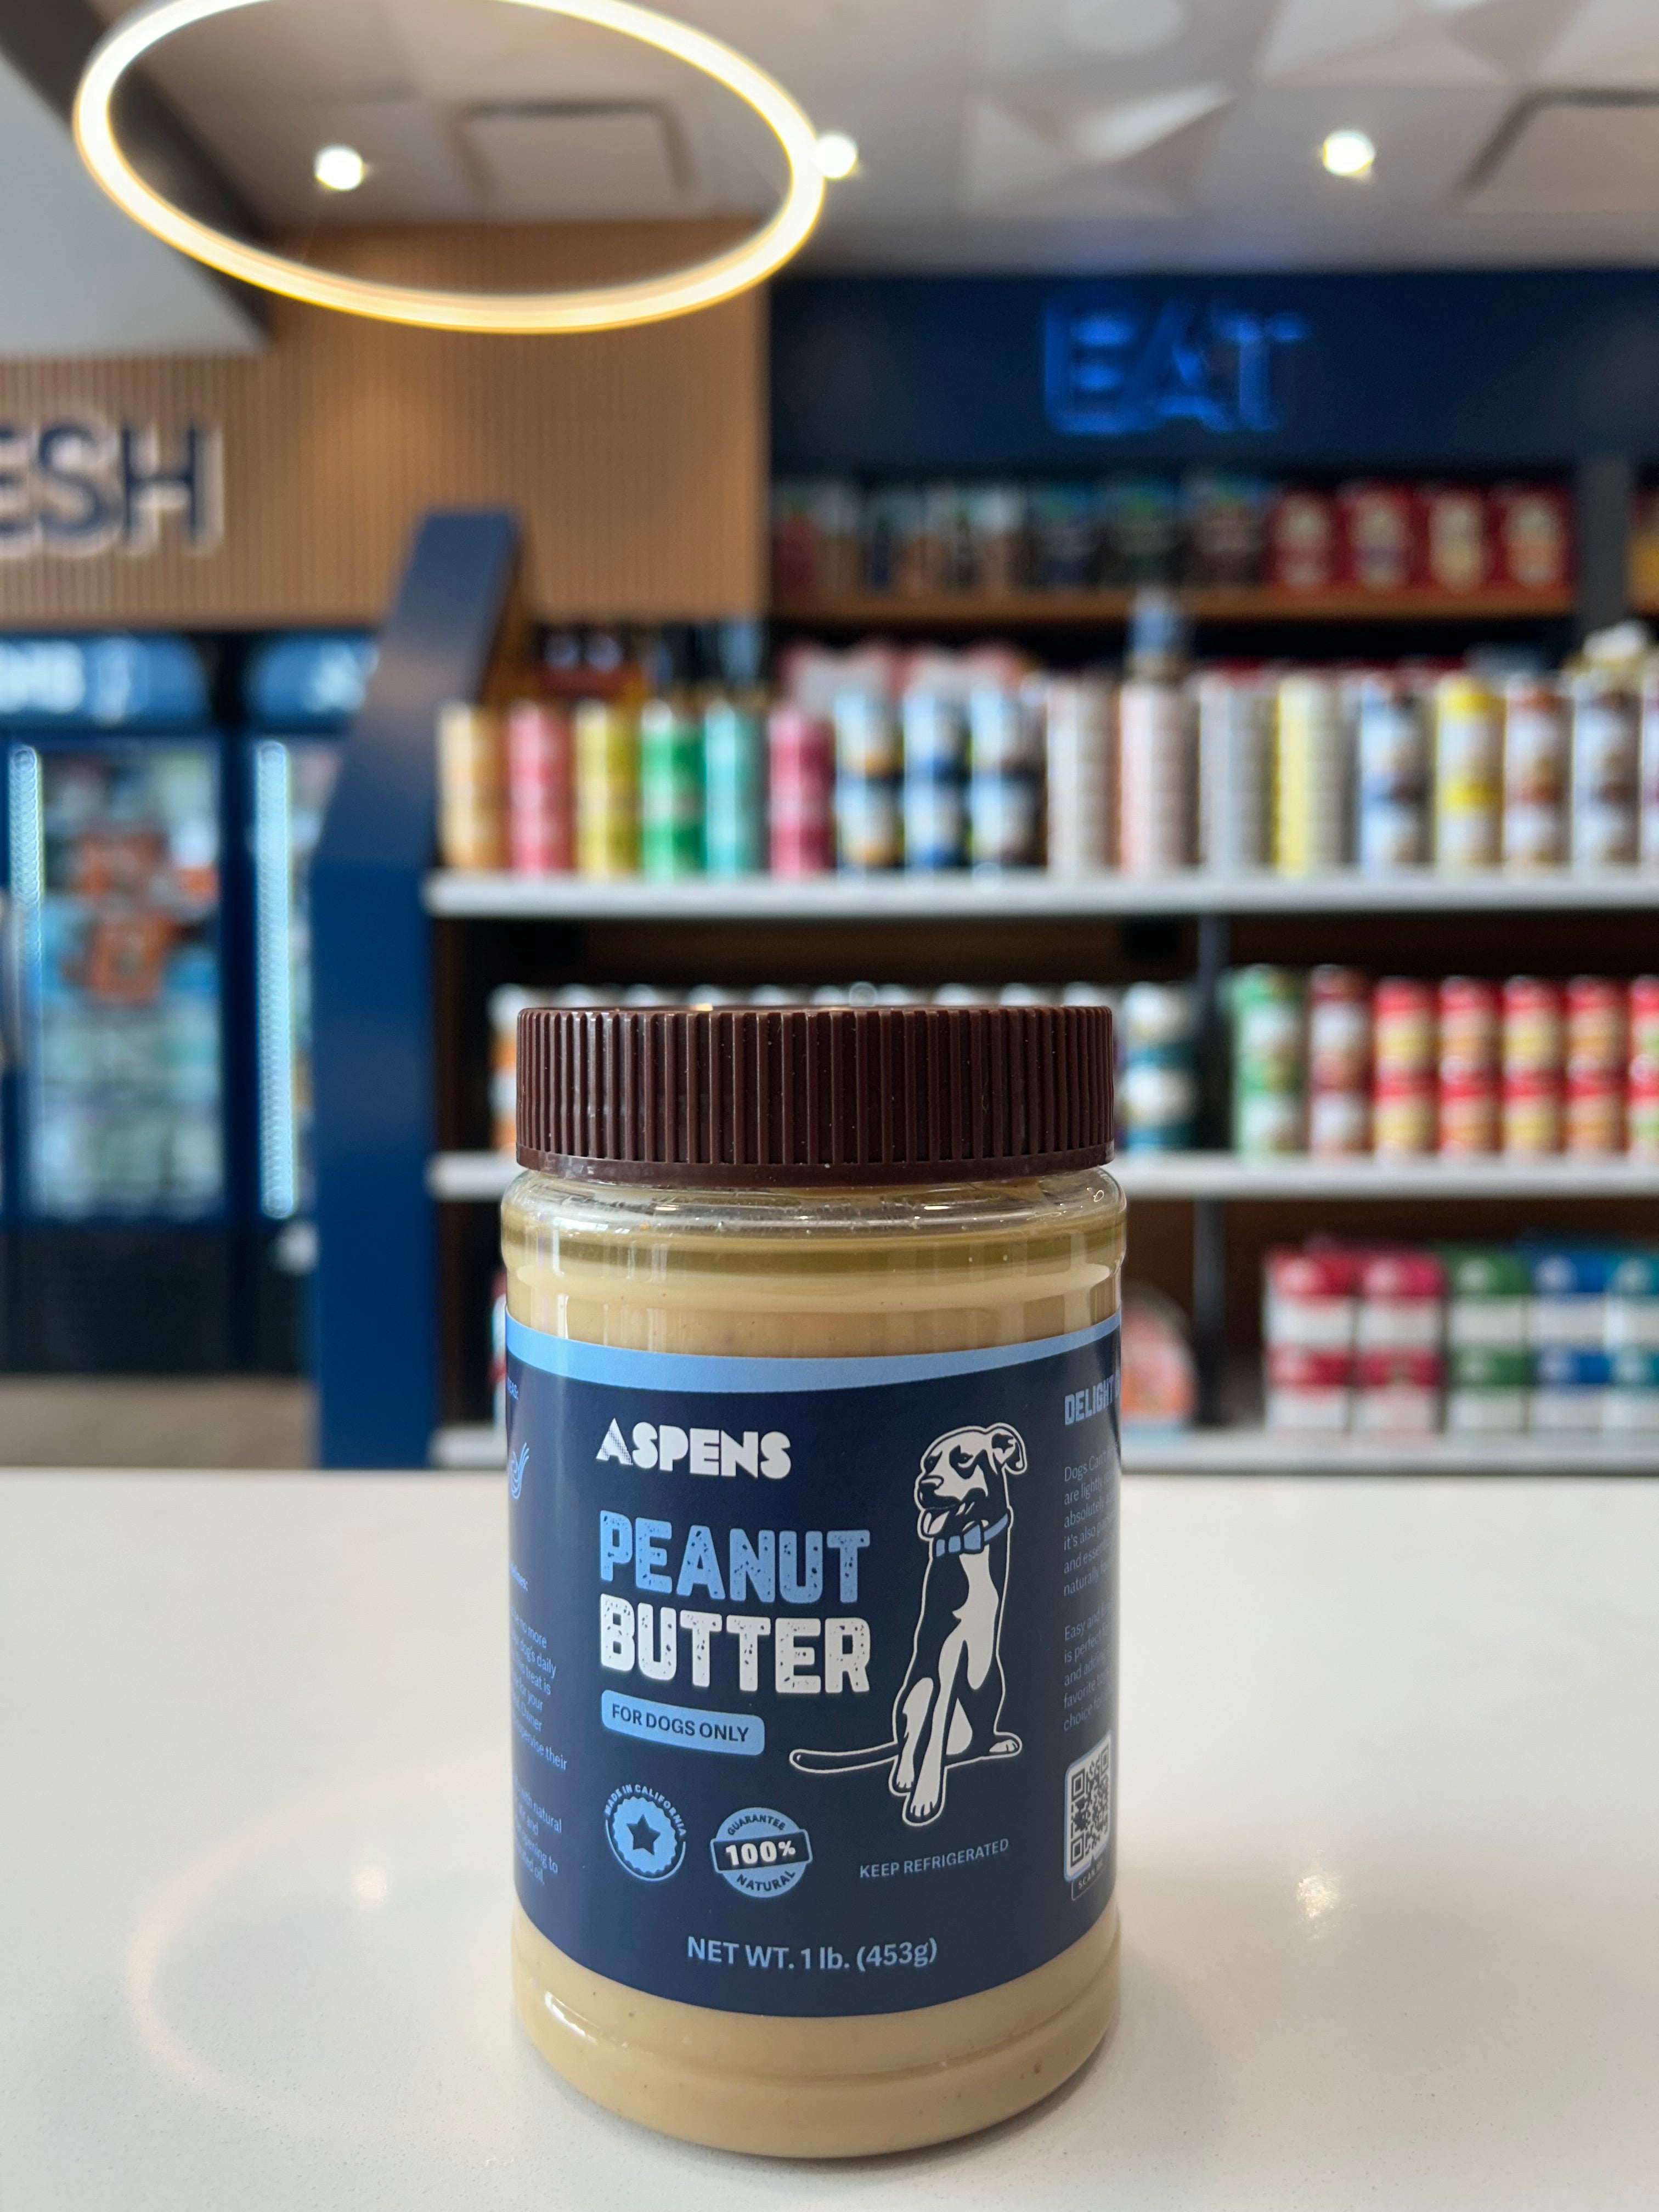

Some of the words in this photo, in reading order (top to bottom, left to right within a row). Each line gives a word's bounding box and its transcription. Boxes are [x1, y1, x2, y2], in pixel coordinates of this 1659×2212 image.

[1043, 299, 1311, 435] EAT
[1064, 1373, 1115, 1425] DELIGHT
[596, 1418, 792, 1479] ASPENS
[1064, 1463, 1087, 1482] Dogs
[1064, 1489, 1079, 1505] are
[1064, 1533, 1078, 1551] it's
[1080, 1526, 1096, 1544] also
[600, 1510, 871, 1603] PEANUT
[1064, 1551, 1081, 1574] and
[527, 1626, 547, 1649] more
[600, 1593, 871, 1694] BUTTER
[1065, 1620, 1086, 1642] Easy
[1064, 1649, 1073, 1664] is
[1074, 1628, 1101, 1663] perfect
[537, 1652, 556, 1679] daily
[1064, 1663, 1082, 1686] and
[544, 1677, 551, 1695] is
[1064, 1680, 1096, 1708] favorite
[612, 1703, 642, 1726] FOR
[646, 1712, 695, 1736] DOGS
[699, 1722, 749, 1742] ONLY
[1064, 1704, 1092, 1731] choice
[545, 1745, 568, 1771] their
[533, 1802, 562, 1833] natural
[605, 1788, 622, 1816] MADE
[622, 1784, 633, 1794] IN
[635, 1784, 686, 1836] CALIFORNIA
[727, 1814, 786, 1836] GUARANTEE
[549, 1854, 558, 1874] to
[725, 1840, 797, 1866] 100%
[860, 1862, 900, 1878] KEEP
[904, 1838, 1009, 1874] REFRIGERATED
[736, 1870, 796, 1892] NATURAL
[687, 1936, 739, 1963] NET
[744, 1945, 794, 1968] WT.
[800, 1949, 811, 1968] 1
[819, 1947, 850, 1970] lb.
[856, 1937, 938, 1972] (453g)
